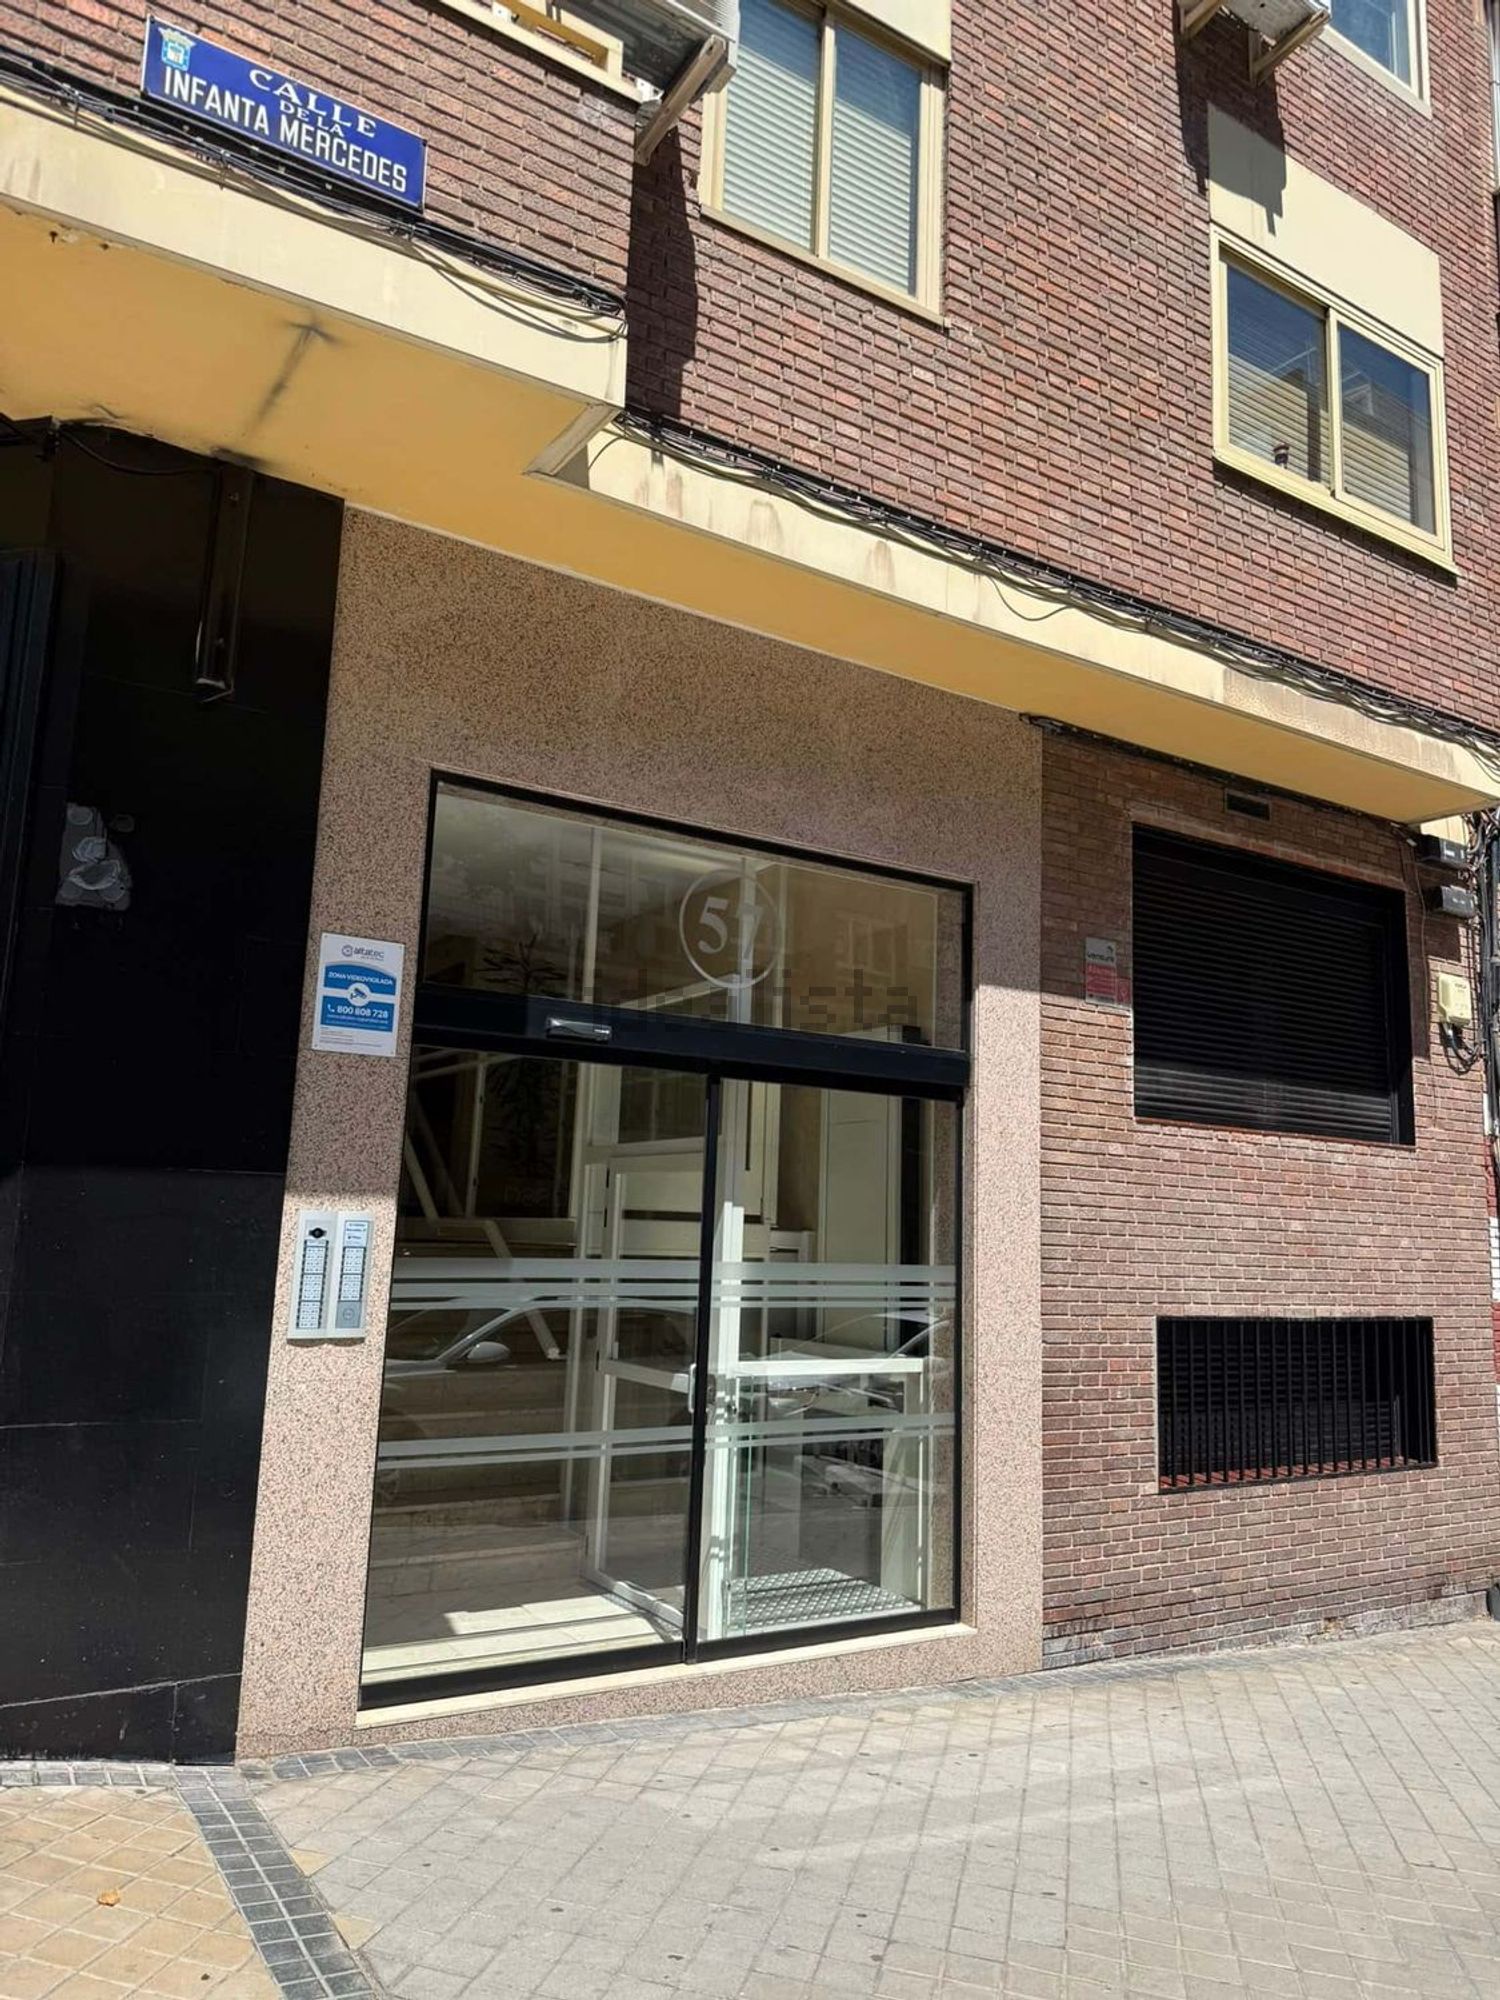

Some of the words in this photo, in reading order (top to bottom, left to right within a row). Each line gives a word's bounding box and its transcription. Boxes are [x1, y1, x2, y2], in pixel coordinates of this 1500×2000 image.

[249, 69, 377, 138] CALLE
[279, 101, 310, 120] DE
[317, 116, 343, 137] LA
[163, 66, 270, 136] INFANTA
[279, 114, 407, 193] MERCEDES
[697, 896, 764, 960] 57
[327, 971, 346, 979] ZONA
[346, 973, 393, 985] VIDEOVIGILADA
[337, 1005, 353, 1015] 800
[372, 1009, 389, 1018] 728
